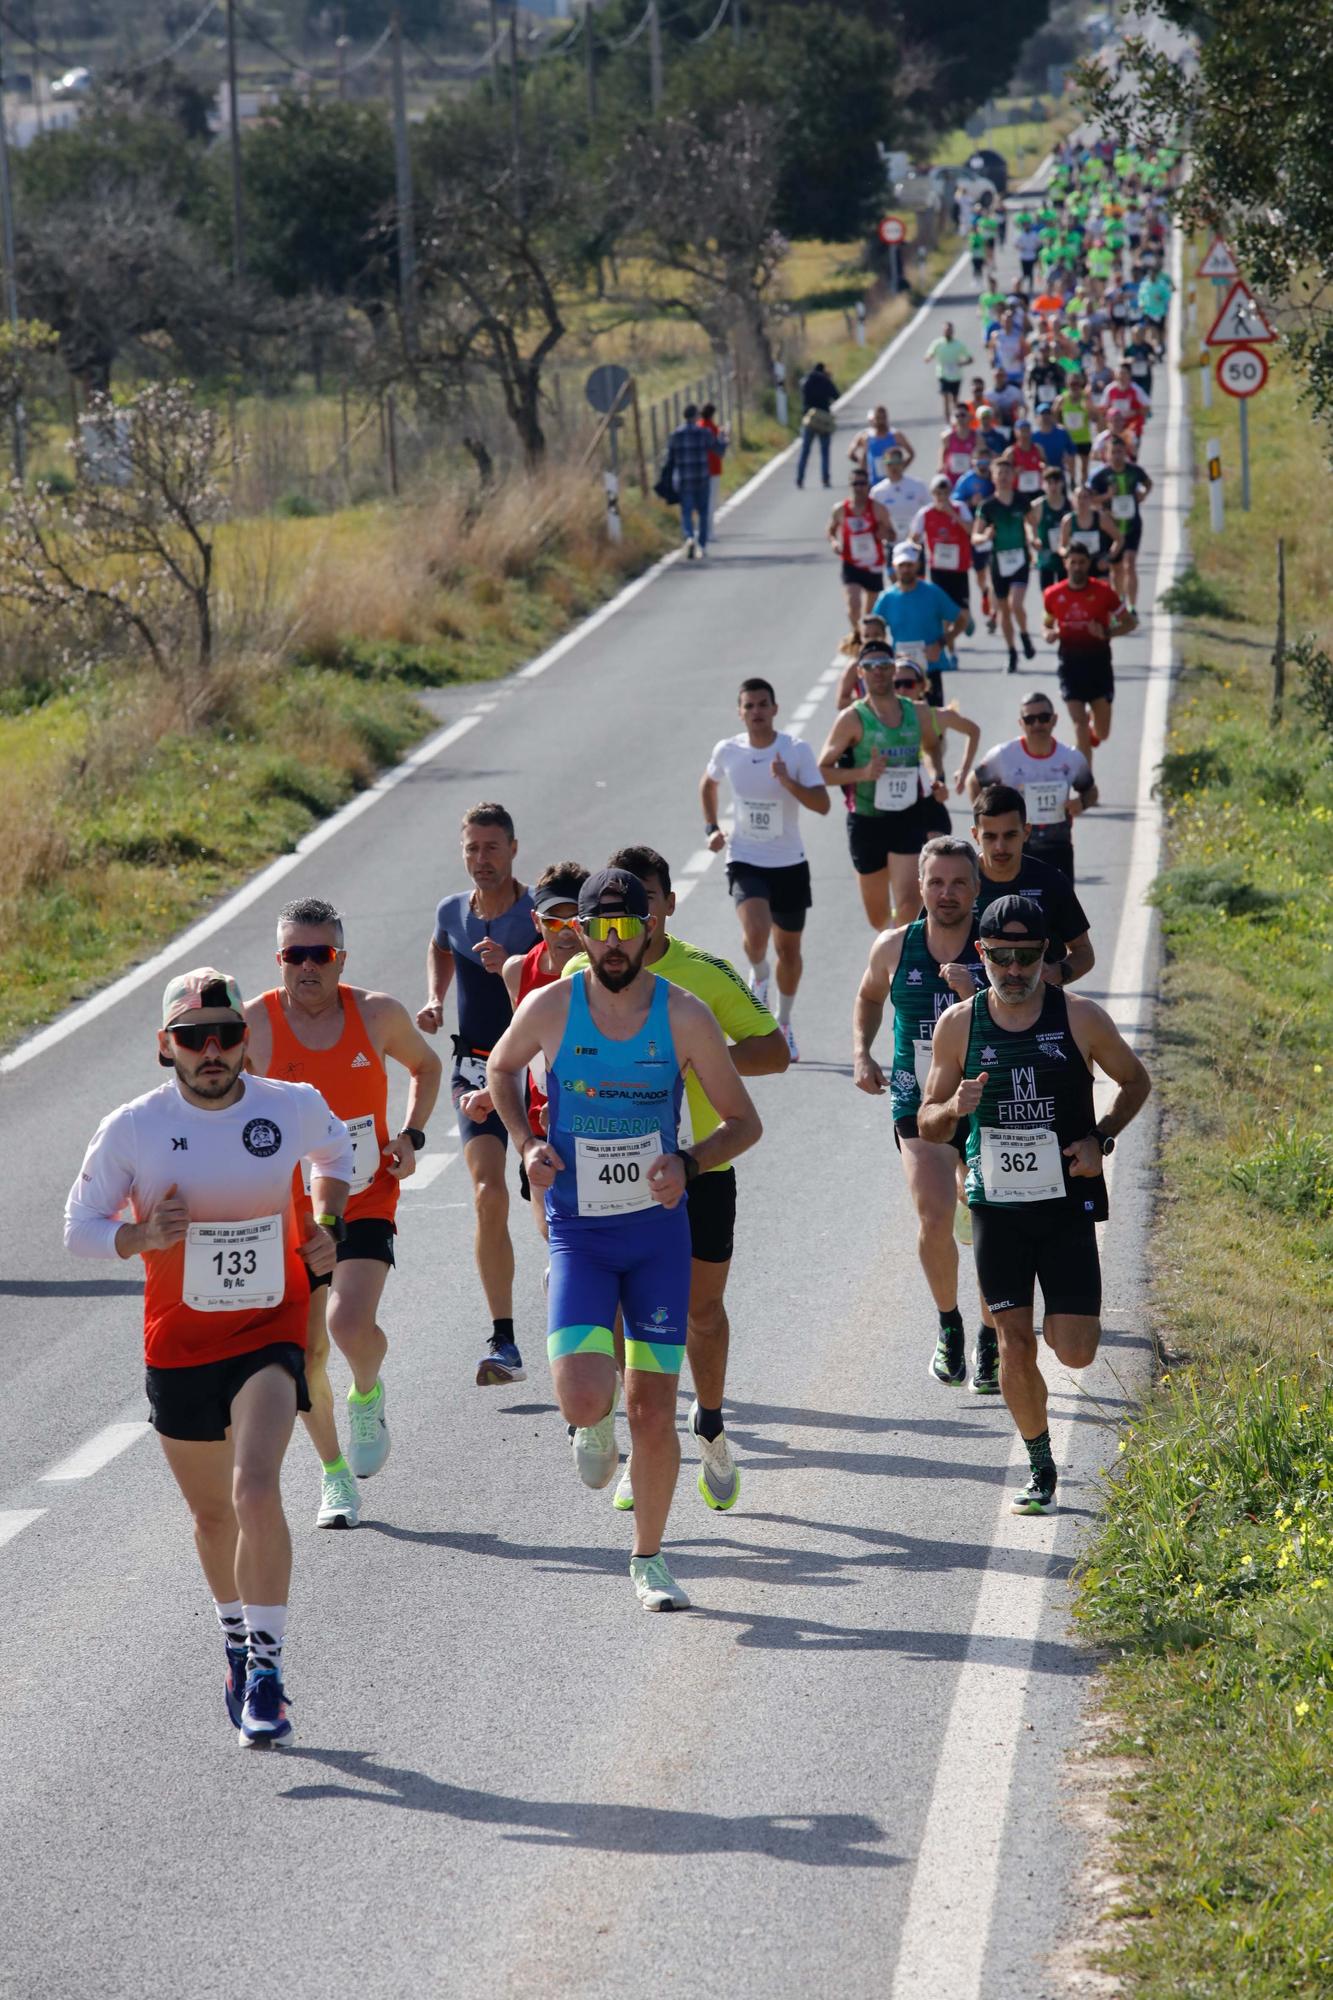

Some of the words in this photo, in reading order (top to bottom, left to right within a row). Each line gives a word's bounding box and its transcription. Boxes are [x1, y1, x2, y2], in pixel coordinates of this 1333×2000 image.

[1229, 363, 1257, 380] 50
[888, 781, 907, 793] 110
[1038, 795, 1056, 806] 113
[598, 1089, 668, 1100] ESPALMADOR
[998, 1101, 1056, 1121] FIRME
[1000, 1152, 1039, 1173] 362
[598, 1162, 640, 1185] 400
[213, 1249, 257, 1276] 133
[223, 1278, 233, 1289] By
[235, 1277, 245, 1288] Ac
